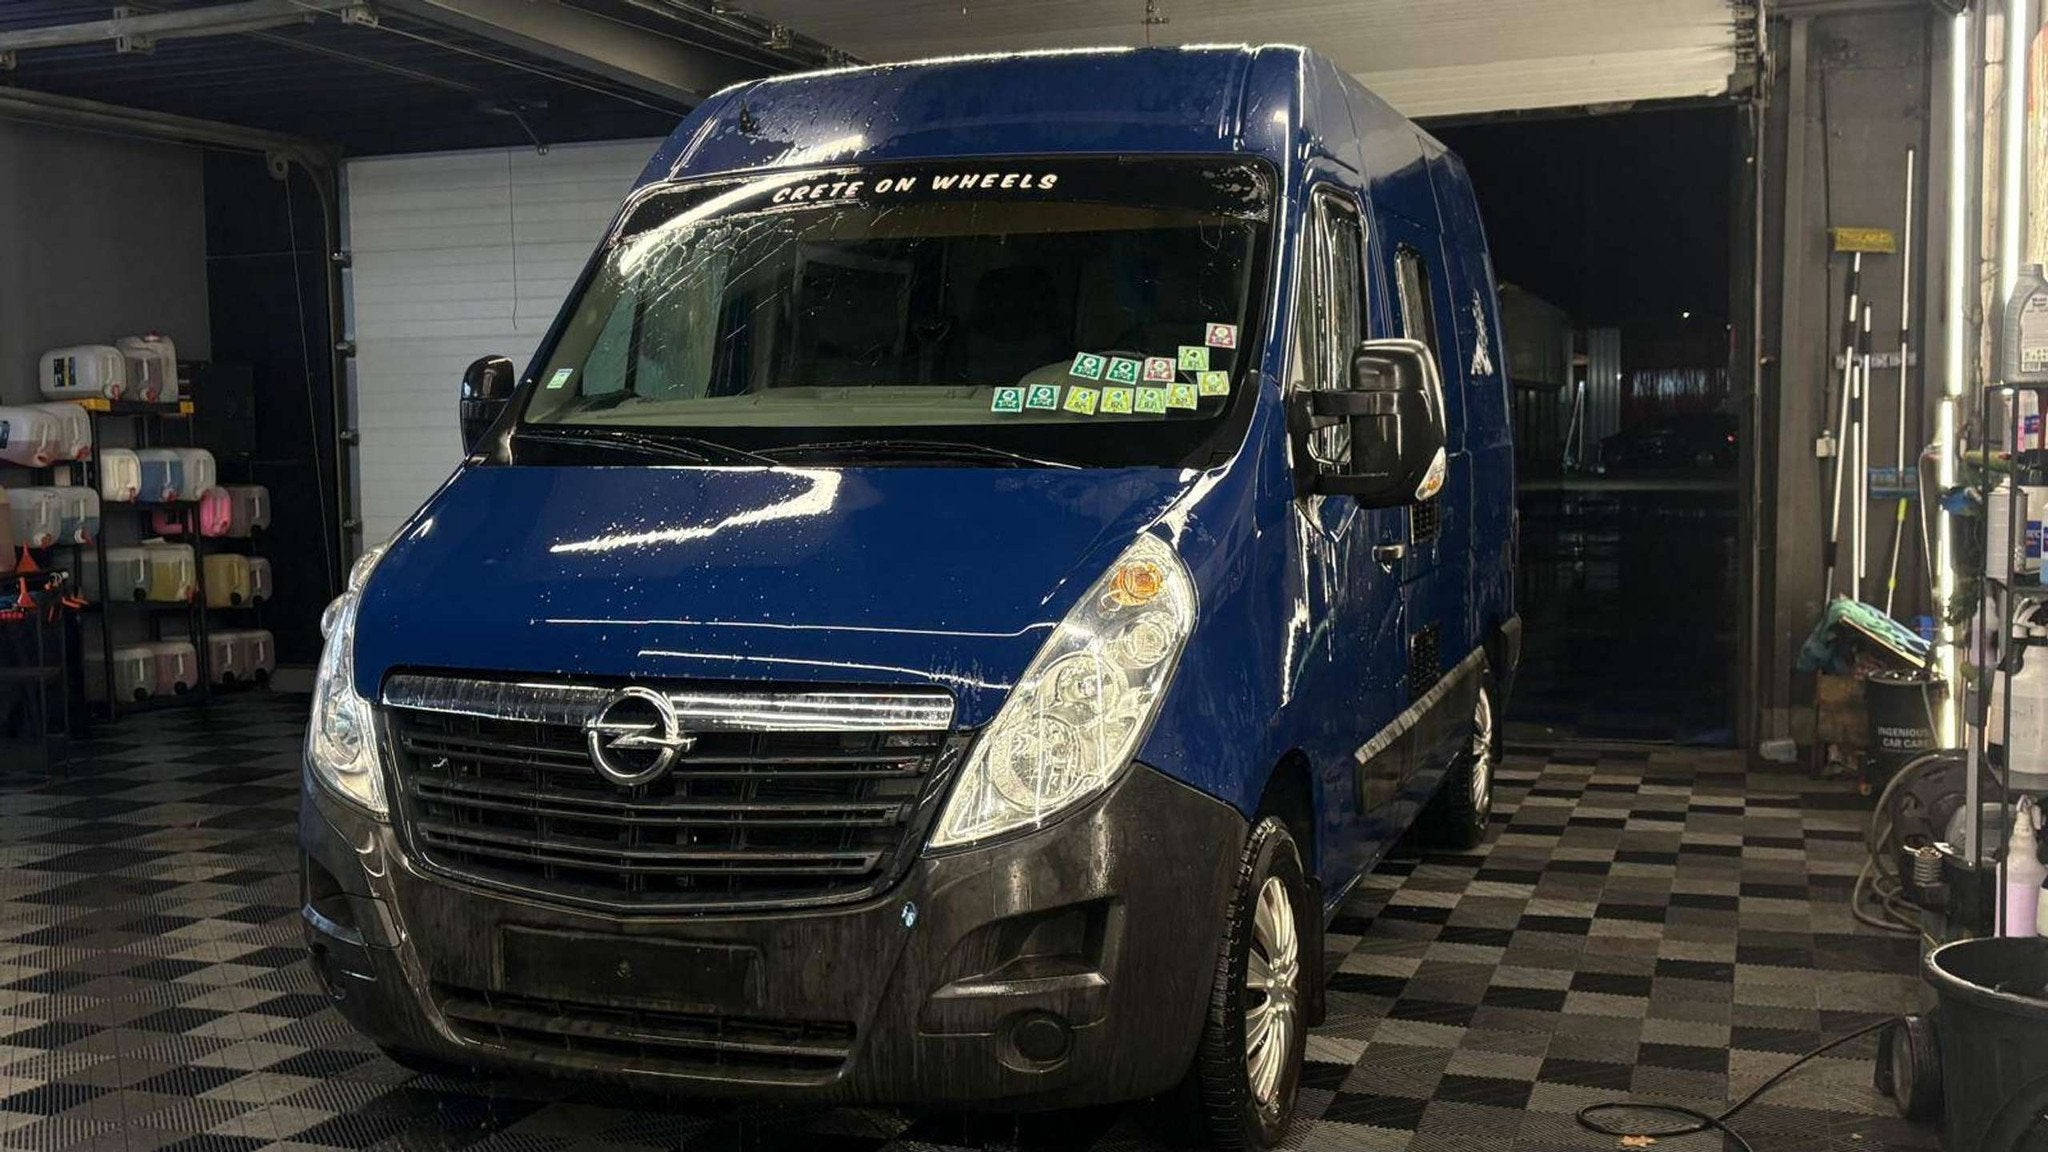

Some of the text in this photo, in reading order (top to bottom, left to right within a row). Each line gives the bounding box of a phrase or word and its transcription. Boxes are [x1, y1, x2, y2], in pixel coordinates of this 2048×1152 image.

[772, 173, 1059, 203] CRETE ON WHEELS
[1877, 726, 1929, 738] INGENIOUS
[1883, 738, 1902, 748] CAR
